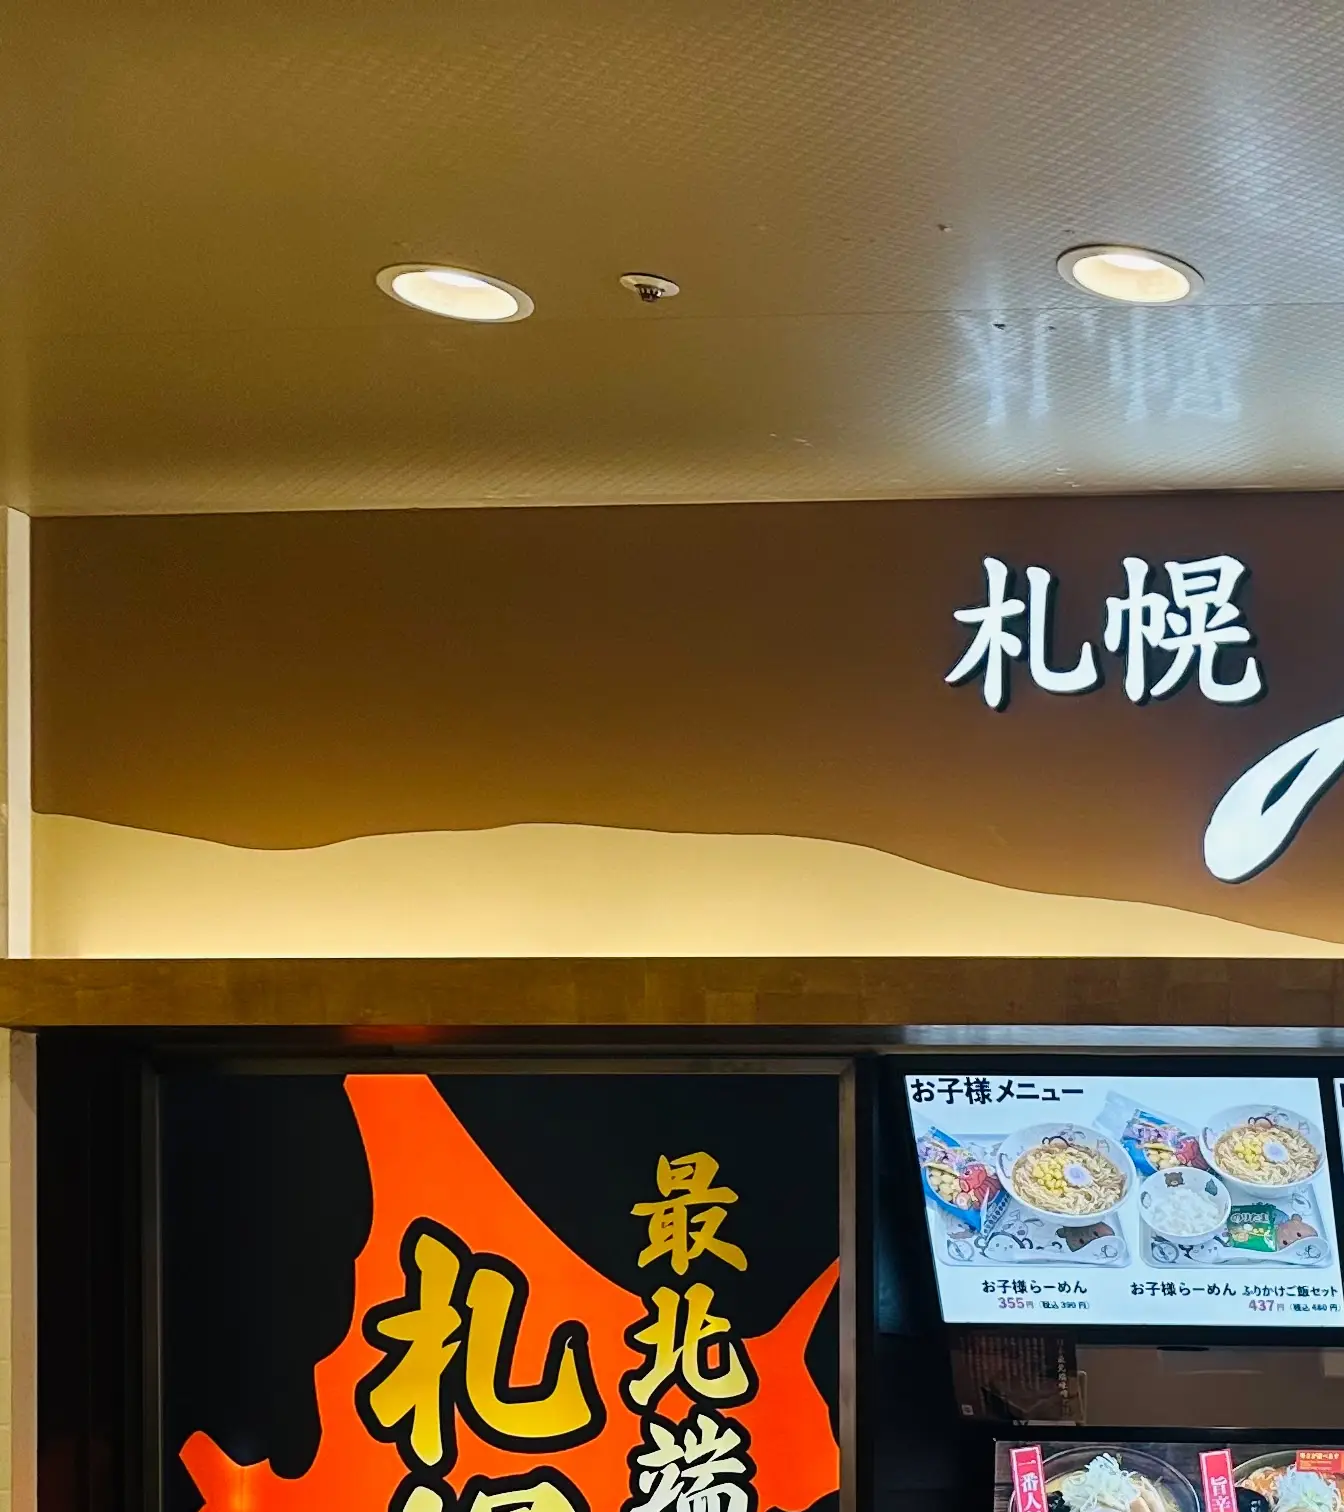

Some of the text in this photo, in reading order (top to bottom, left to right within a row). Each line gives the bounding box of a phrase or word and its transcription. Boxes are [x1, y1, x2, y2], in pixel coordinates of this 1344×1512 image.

[945, 552, 1264, 712] 札幌
[910, 1077, 1084, 1105] お子様メニュー
[981, 1279, 1088, 1295] お子様らーめん
[1130, 1281, 1339, 1298] お子様らーめん ふりかけご飯セット
